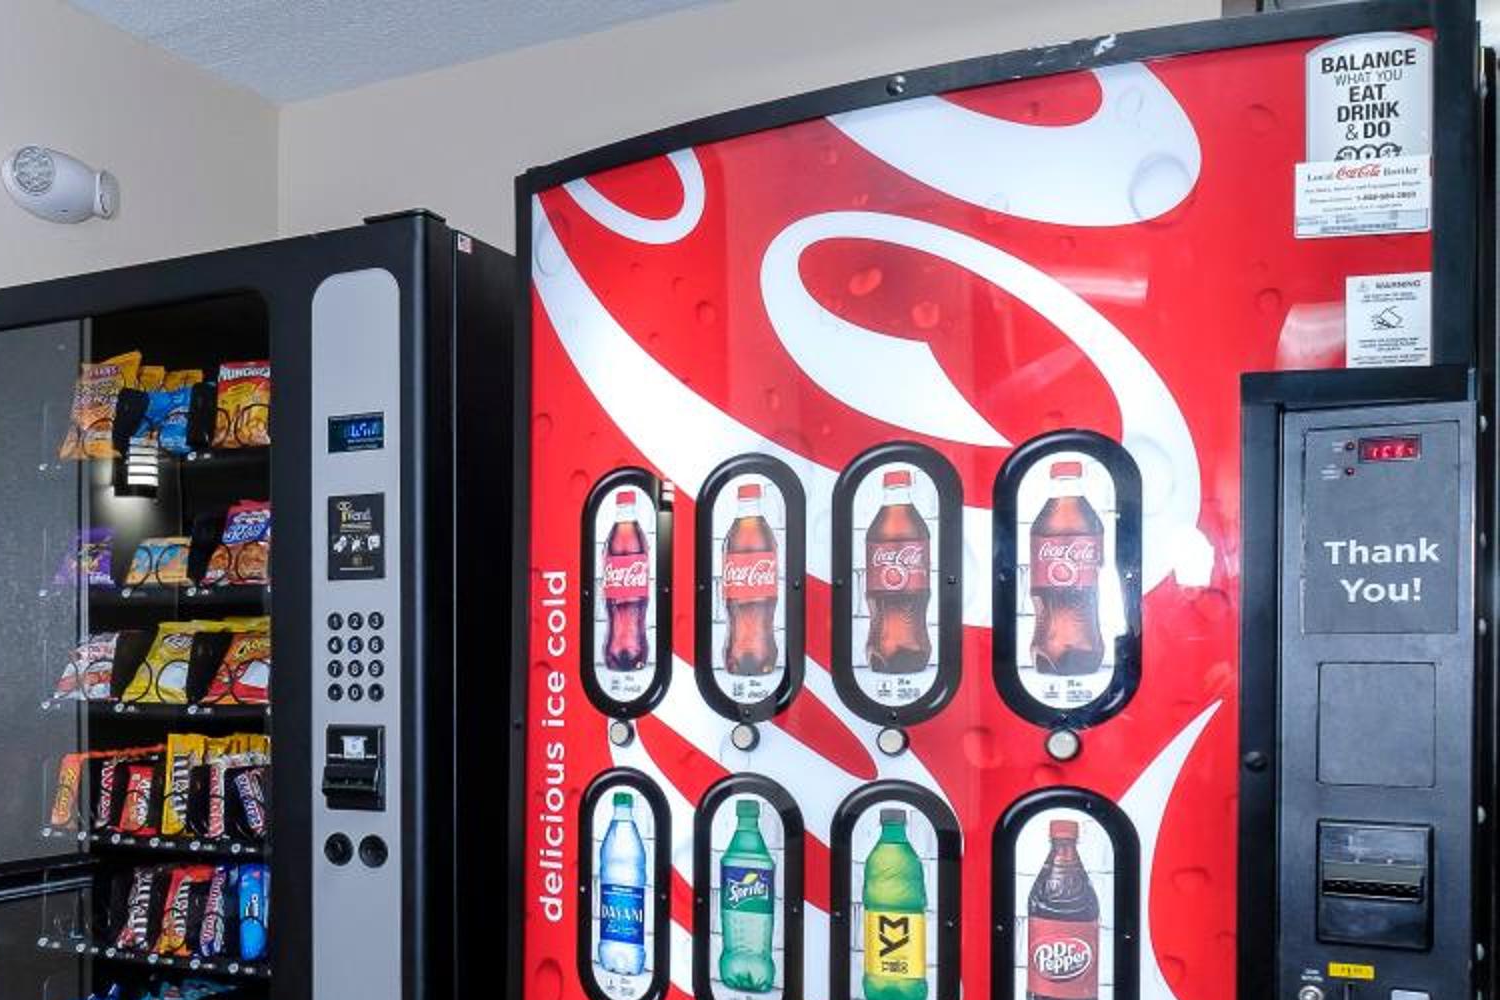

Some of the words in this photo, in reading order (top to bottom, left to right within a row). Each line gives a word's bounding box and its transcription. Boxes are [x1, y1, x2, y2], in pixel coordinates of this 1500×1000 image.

[1321, 48, 1416, 75] BALANCE
[1334, 71, 1371, 86] WHAT
[1376, 69, 1402, 82] YOU
[1349, 84, 1386, 102] EAT
[1337, 101, 1400, 122] DRINK
[1345, 124, 1358, 141] &
[1363, 120, 1391, 139] DO
[1324, 537, 1440, 565] Thank
[1339, 577, 1422, 603] You!
[541, 571, 567, 657] cold
[542, 671, 565, 727] ice
[540, 742, 566, 922] delicious
[727, 880, 767, 902] Sprite
[1034, 944, 1092, 974] Pepper
[1053, 941, 1078, 958] Dr
